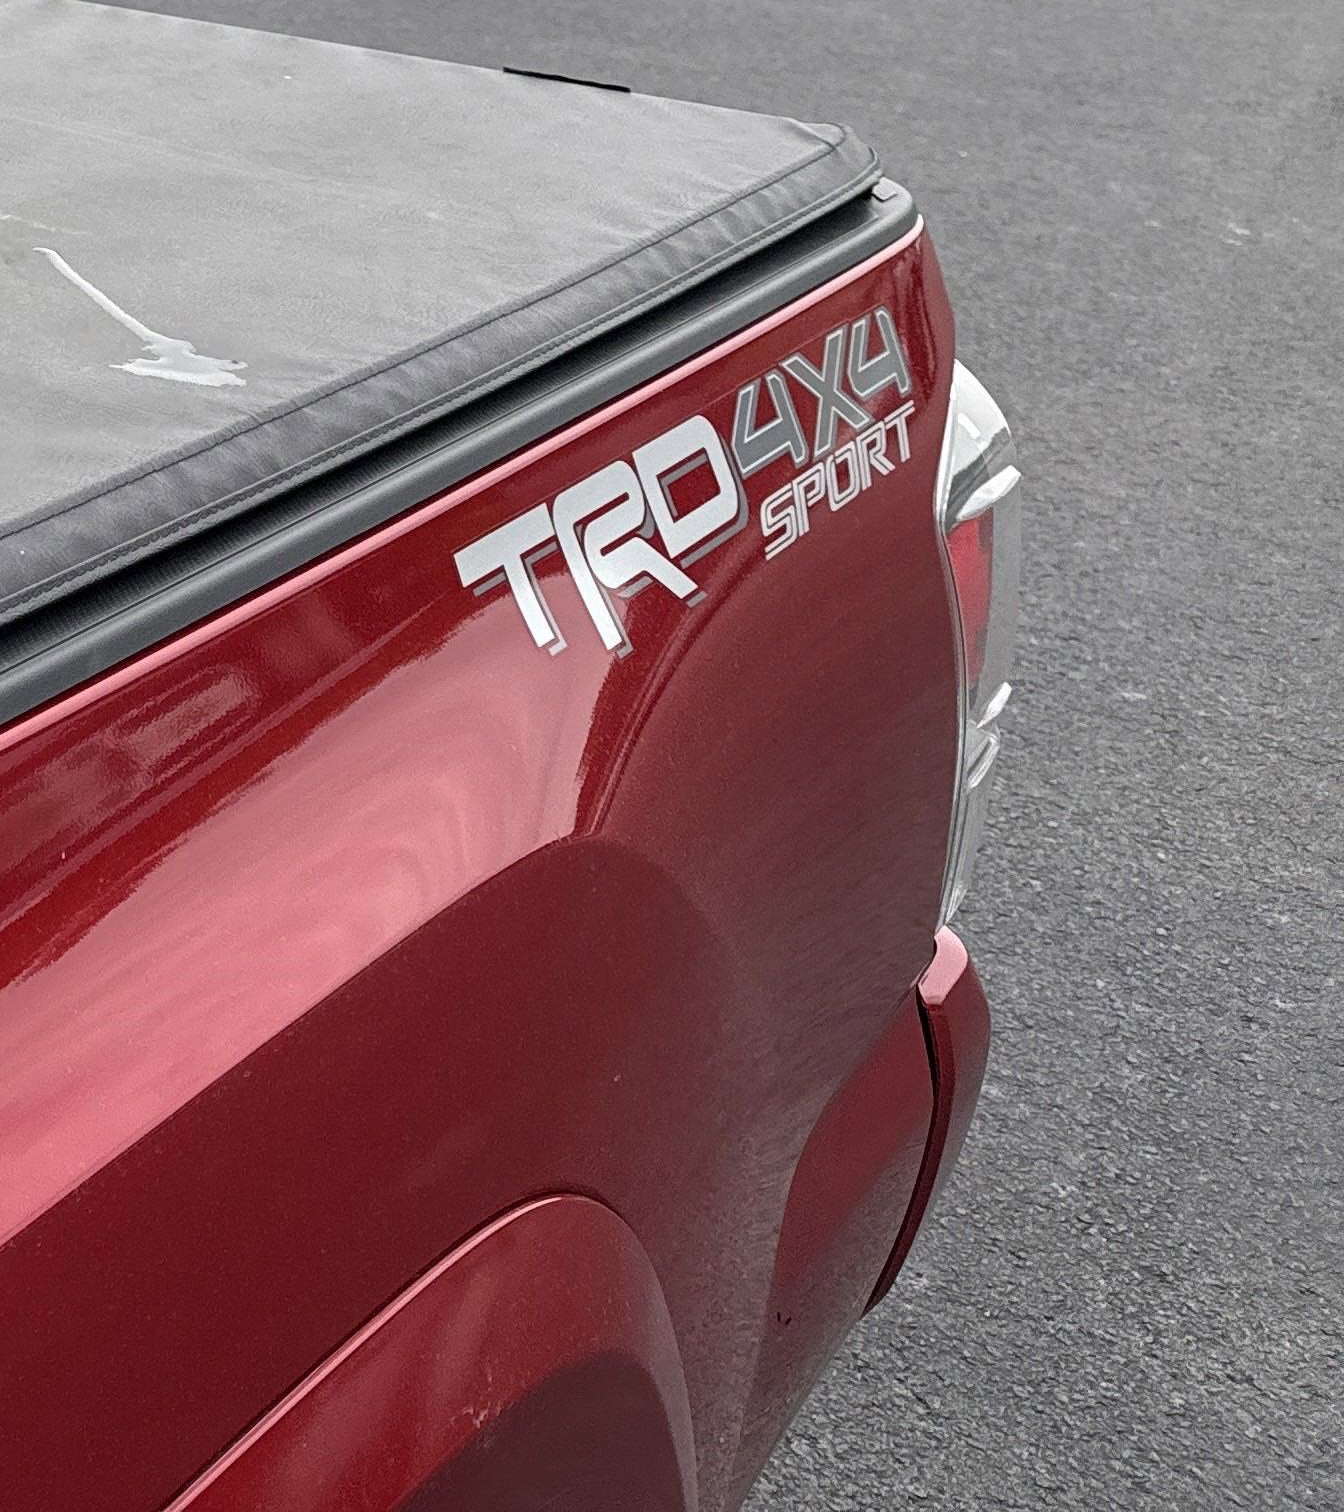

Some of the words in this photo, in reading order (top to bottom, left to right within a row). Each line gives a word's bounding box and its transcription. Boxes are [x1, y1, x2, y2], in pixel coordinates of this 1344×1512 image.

[452, 414, 749, 658] TRD
[730, 305, 913, 480] 4X4
[759, 400, 916, 561] SPORT
